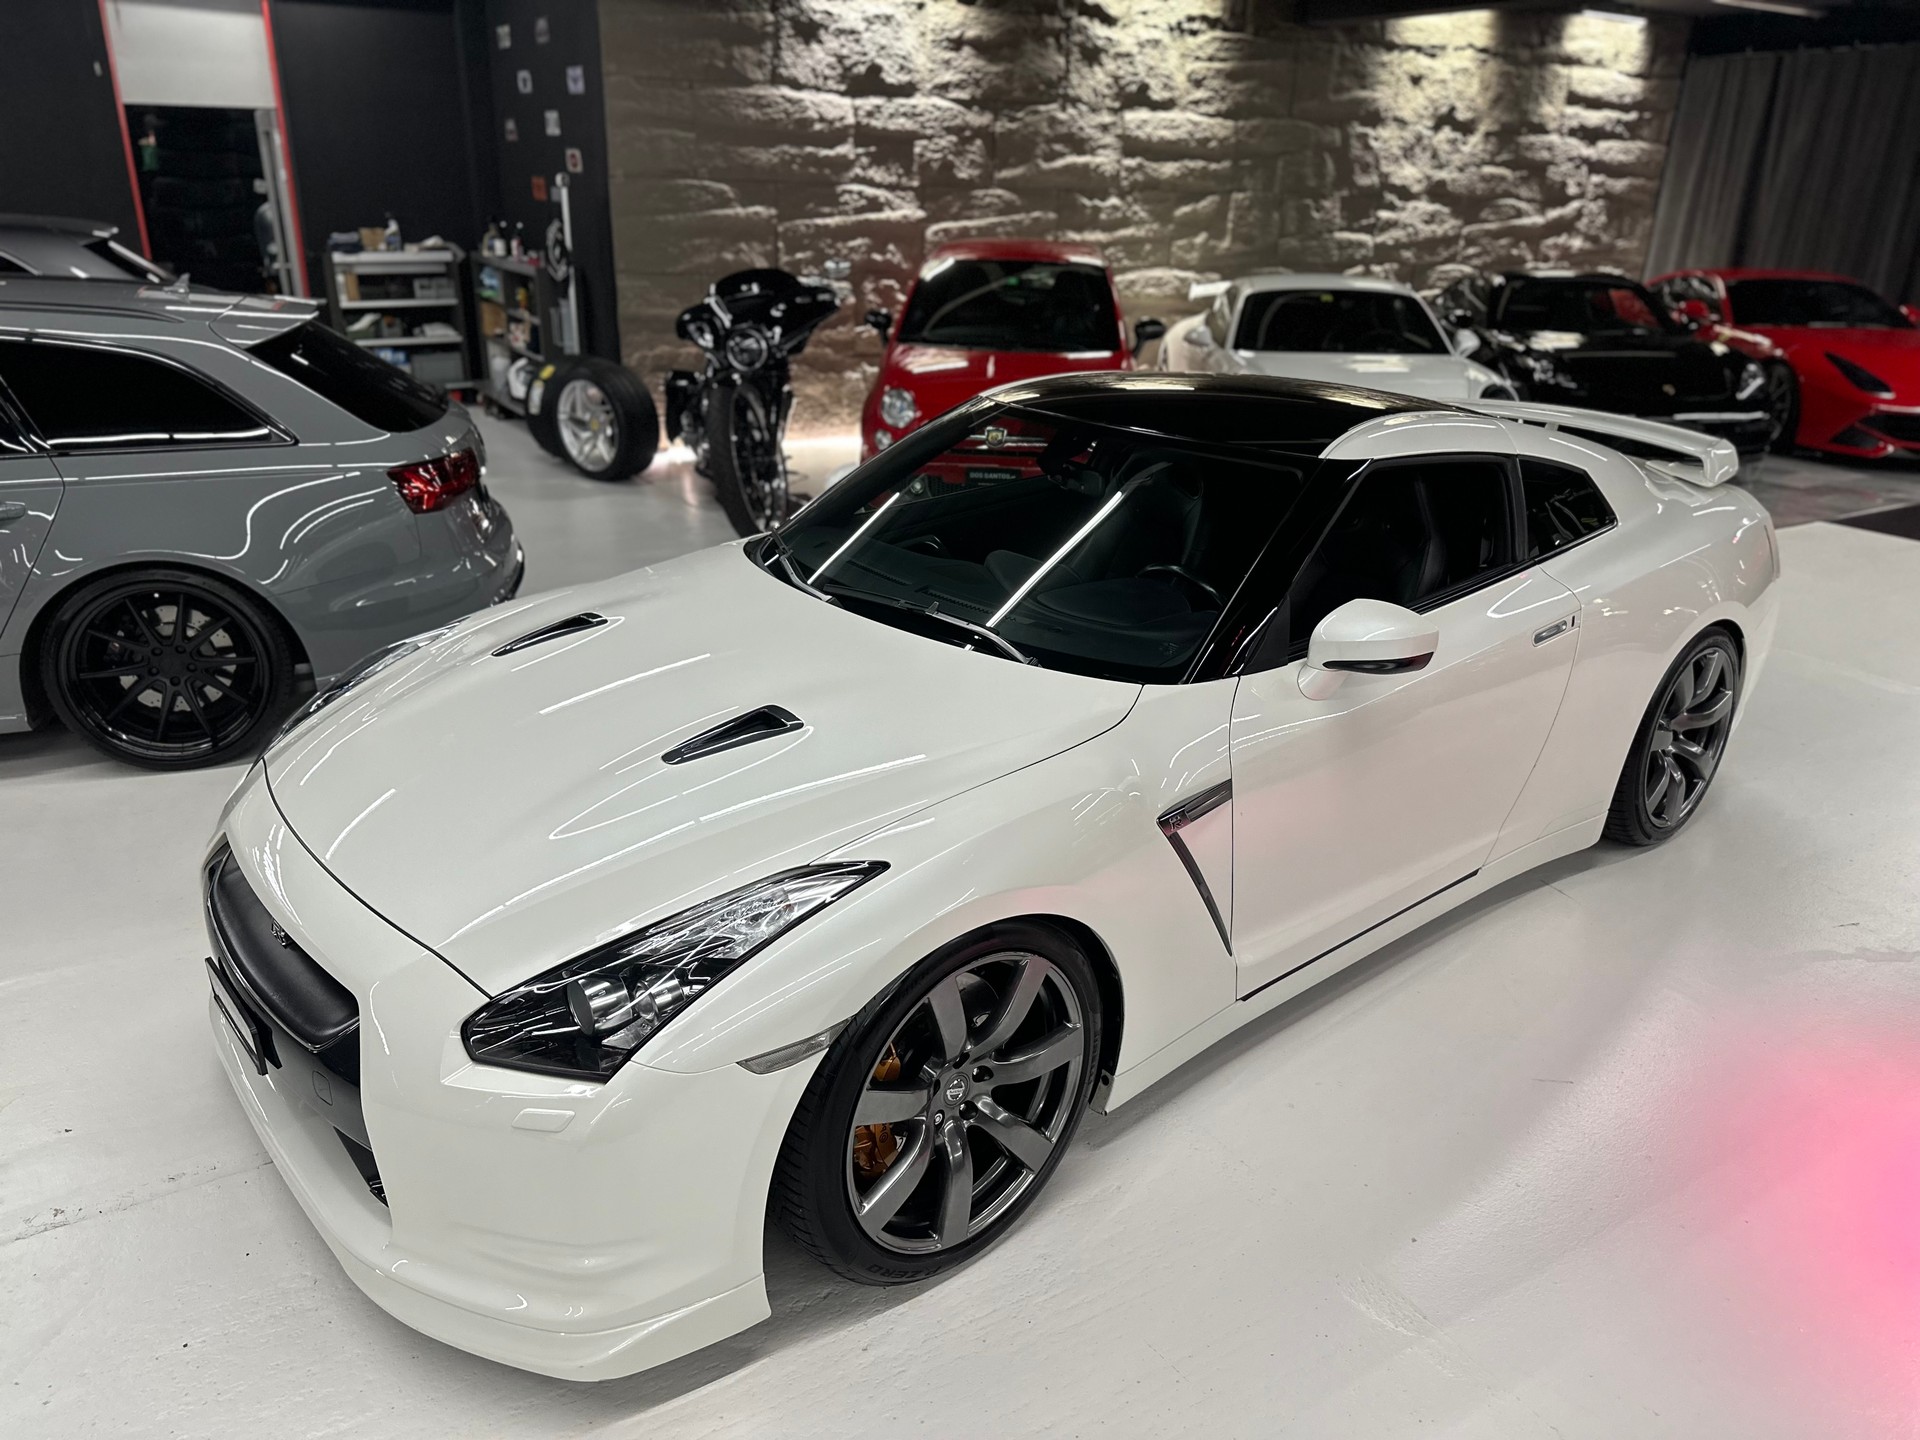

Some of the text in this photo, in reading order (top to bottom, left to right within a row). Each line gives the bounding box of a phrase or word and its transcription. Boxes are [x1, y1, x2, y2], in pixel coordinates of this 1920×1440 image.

[969, 471, 983, 479] DOS
[984, 472, 1011, 480] SANTOS
[866, 1264, 923, 1279] ZERO
